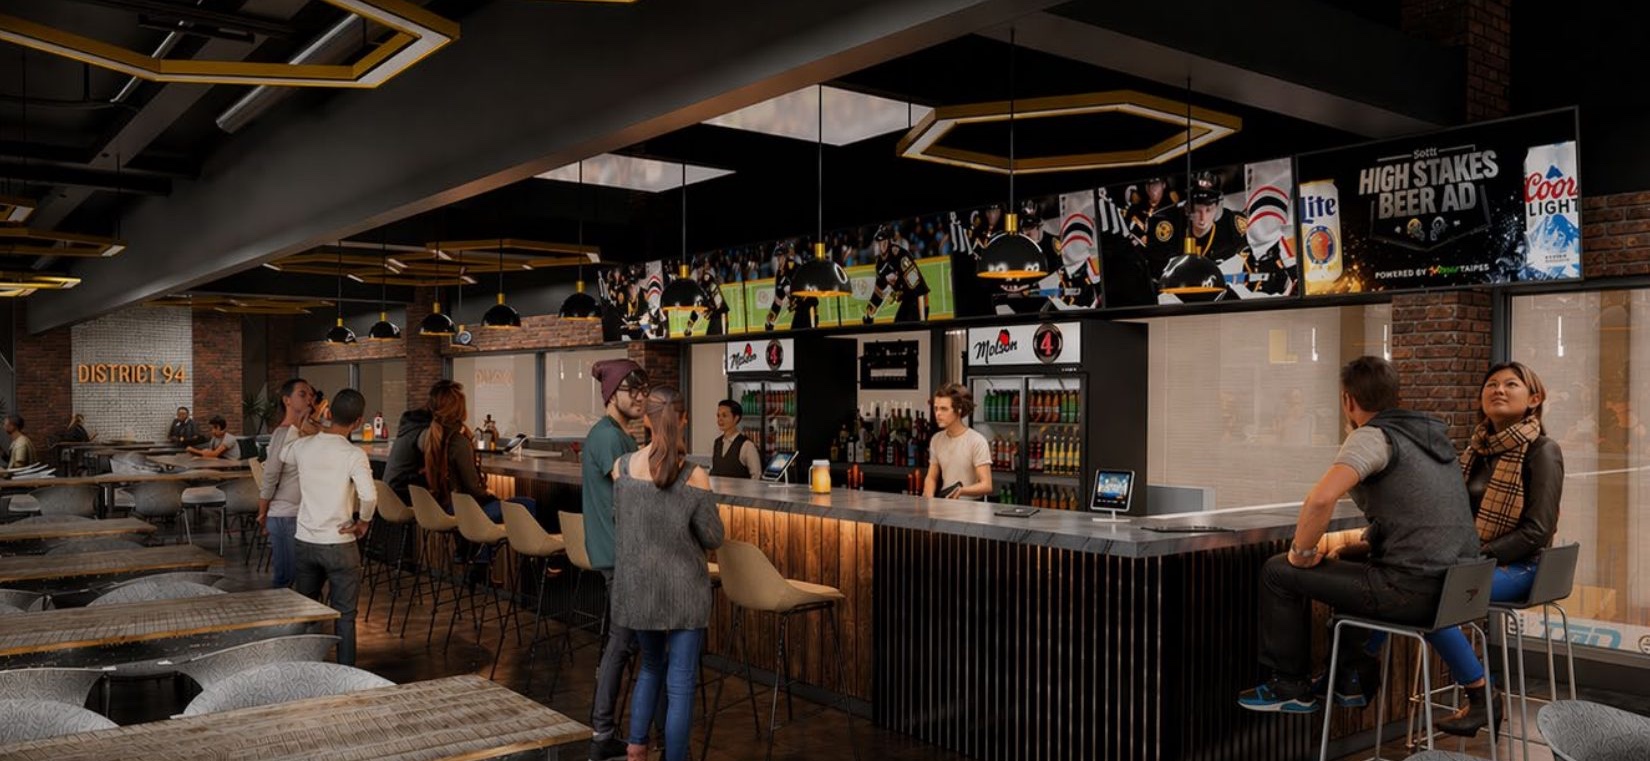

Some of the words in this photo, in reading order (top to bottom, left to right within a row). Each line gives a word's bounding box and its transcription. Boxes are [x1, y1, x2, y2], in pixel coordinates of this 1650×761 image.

[1359, 163, 1410, 195] HIGH
[1412, 150, 1499, 187] STAKES
[1524, 172, 1580, 203] Coor
[1299, 195, 1337, 224] Lite
[1379, 186, 1437, 219] BEER
[1441, 182, 1477, 213] AD
[1528, 198, 1579, 217] LIGHT
[973, 338, 1018, 365] Molson
[1040, 331, 1055, 356] 4
[78, 363, 159, 384] DISTRICT
[162, 363, 186, 384] 94
